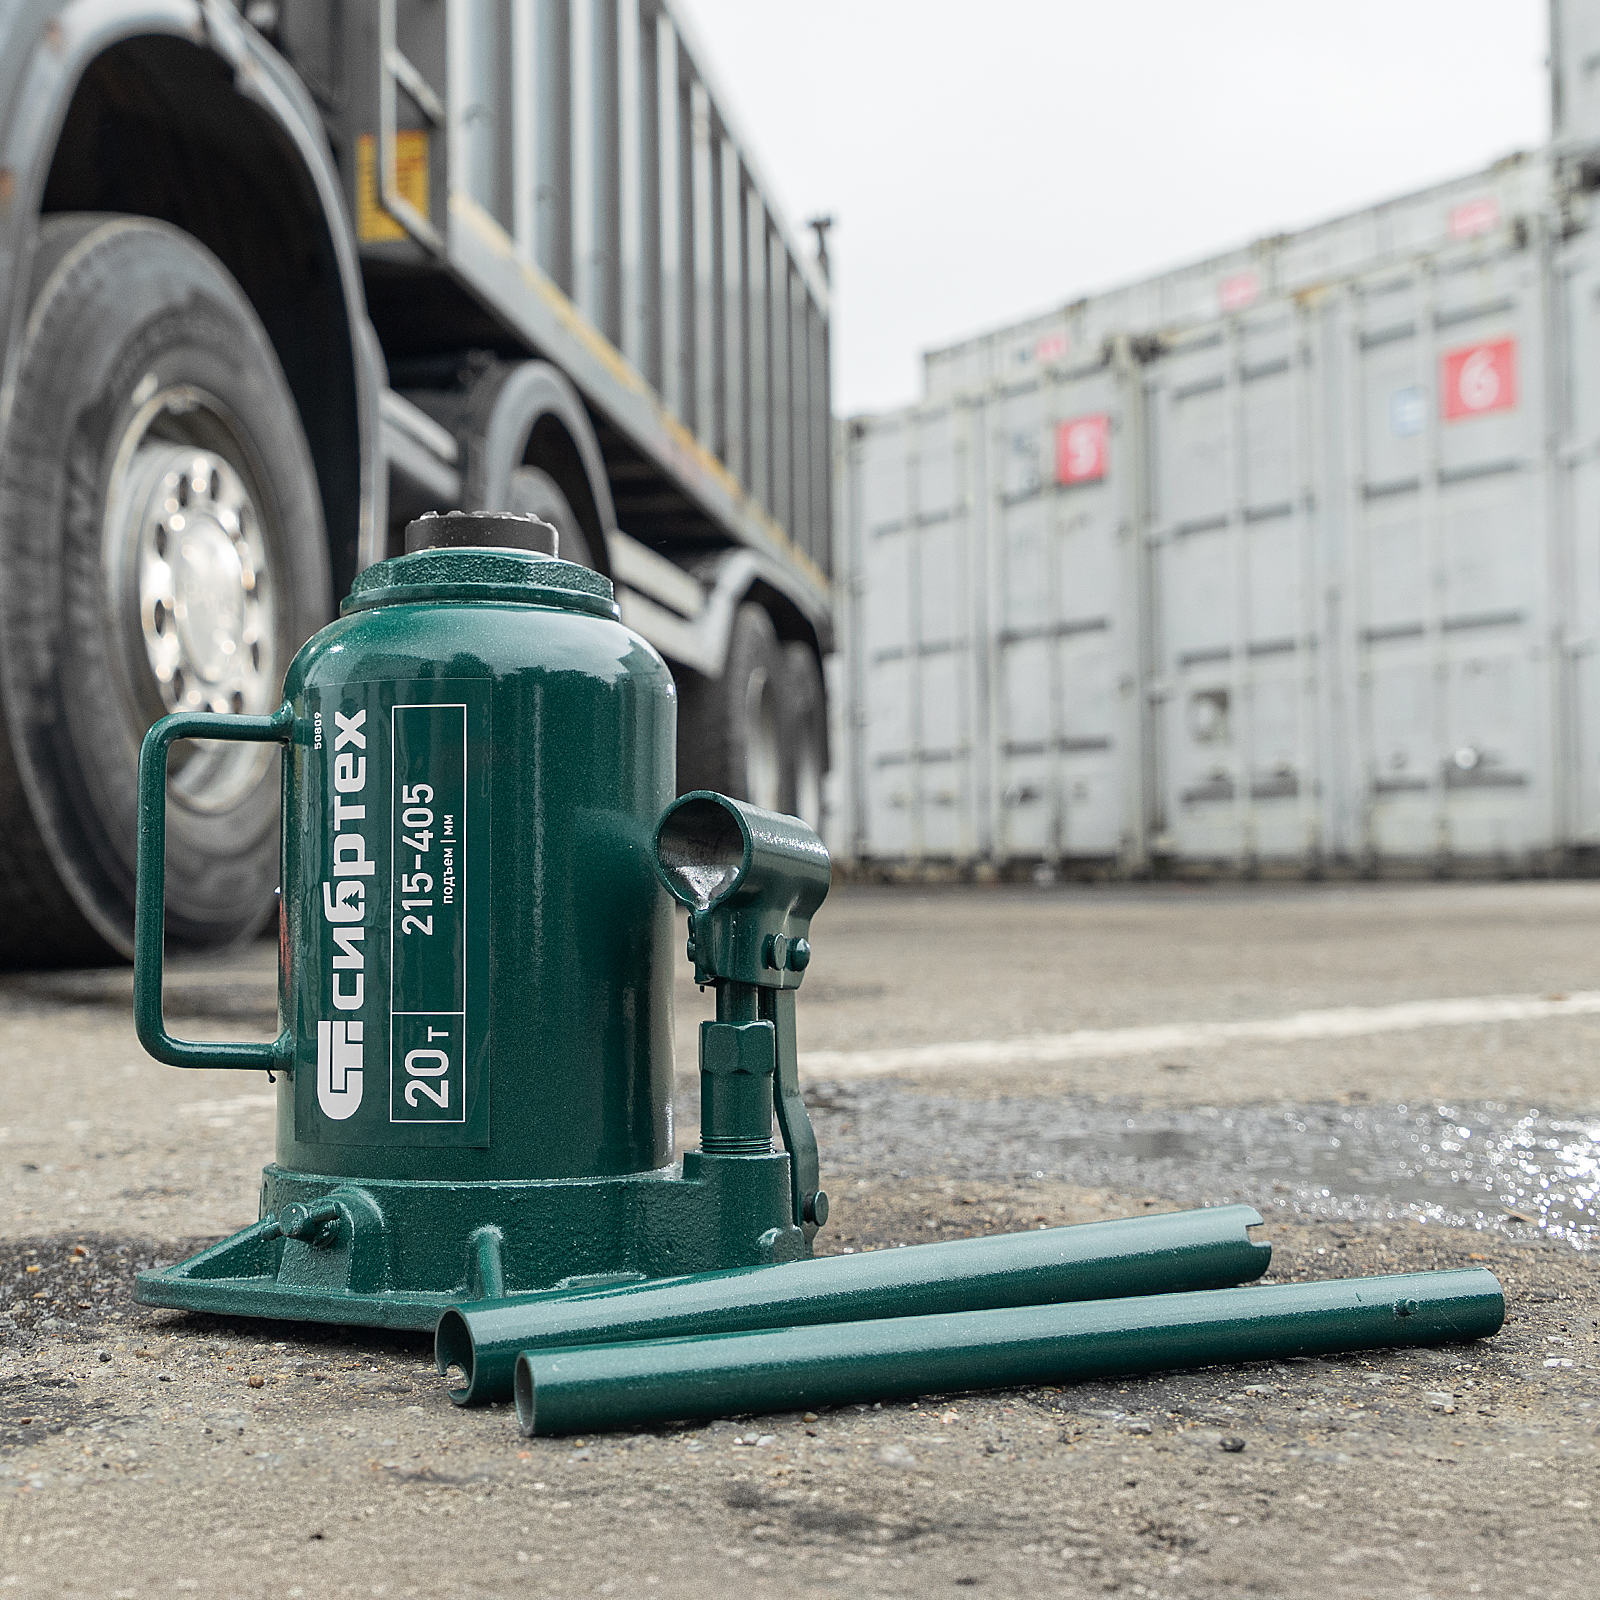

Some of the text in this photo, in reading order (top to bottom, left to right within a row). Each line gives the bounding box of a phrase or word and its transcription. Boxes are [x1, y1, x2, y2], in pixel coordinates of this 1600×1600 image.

[1458, 349, 1500, 410] 6
[314, 711, 322, 750] 50809
[443, 814, 454, 836] мм
[323, 709, 376, 1010] сибртех
[401, 783, 434, 936] 215-405
[443, 847, 456, 904] подъем
[404, 1049, 449, 1108] 20
